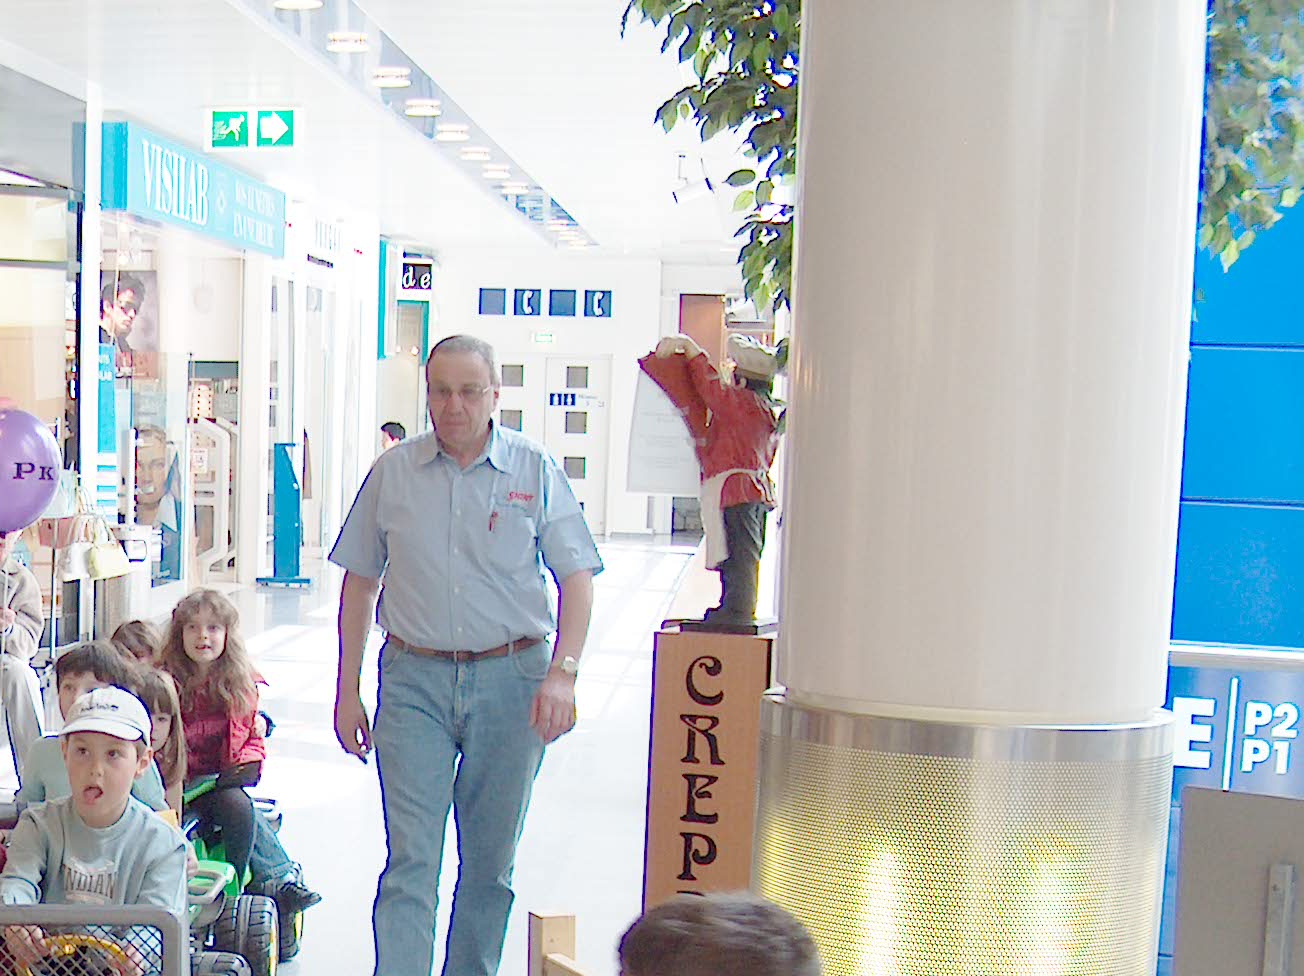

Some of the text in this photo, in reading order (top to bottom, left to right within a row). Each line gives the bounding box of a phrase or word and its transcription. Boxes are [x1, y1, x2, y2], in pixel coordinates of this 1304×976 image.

[142, 138, 209, 227] VISILAB
[1243, 700, 1300, 739] P2
[676, 655, 727, 897] CREP
[1240, 737, 1291, 775] P1
